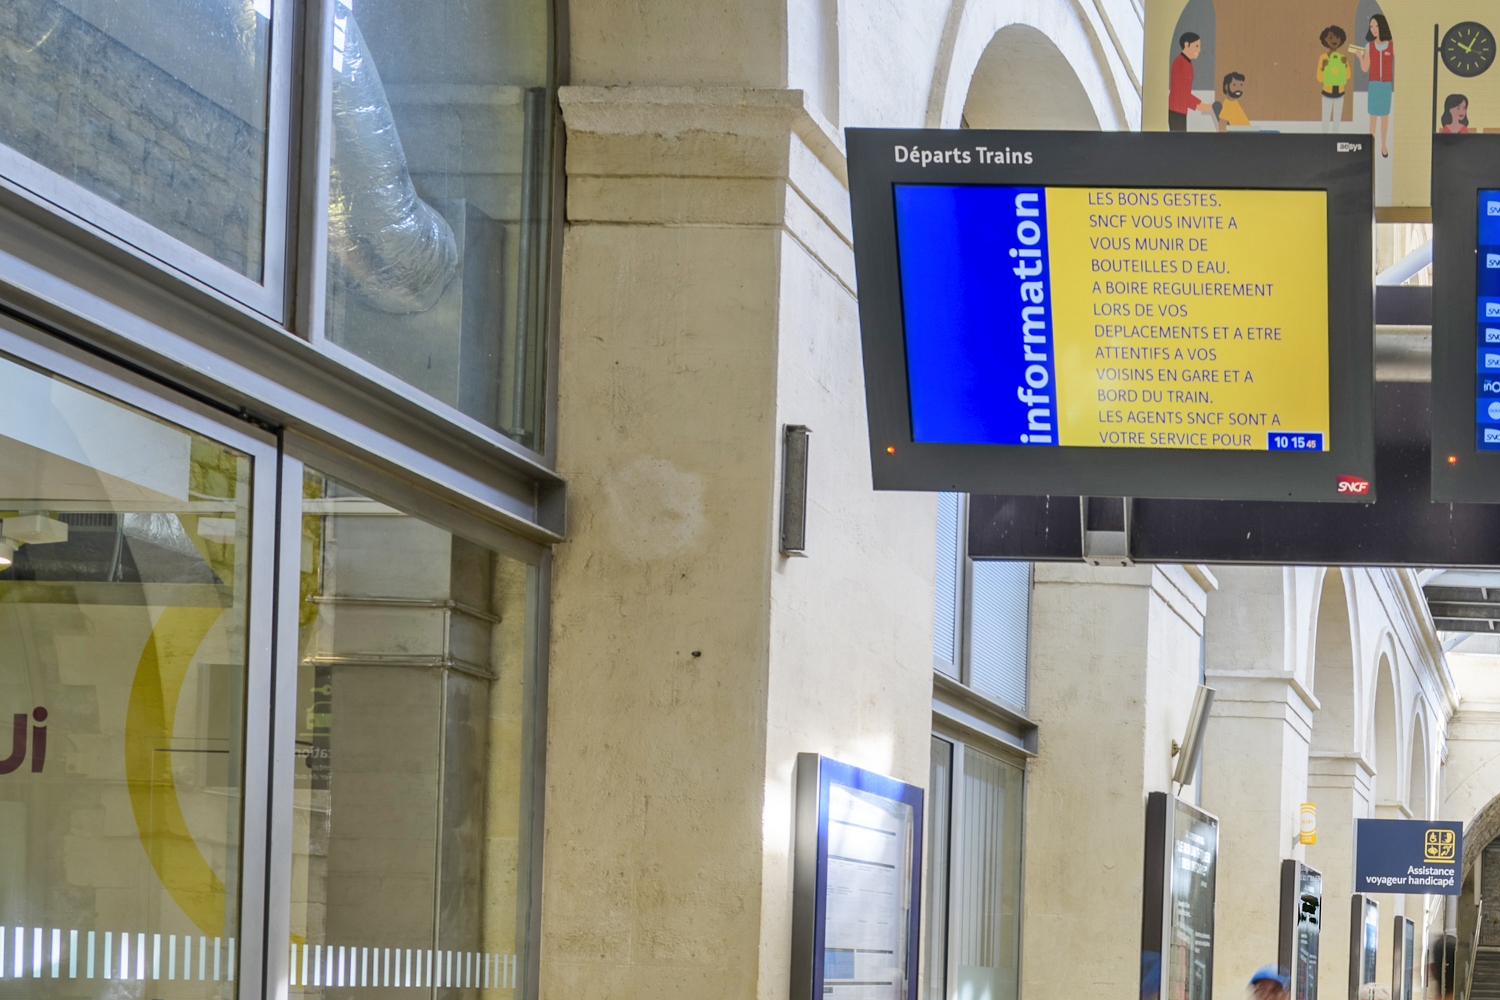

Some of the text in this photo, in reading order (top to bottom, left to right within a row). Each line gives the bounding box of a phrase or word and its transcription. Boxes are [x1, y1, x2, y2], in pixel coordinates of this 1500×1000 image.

[895, 146, 1033, 167] Départs Trains
[1089, 192, 1221, 206] LES BONS GESTES.
[1090, 214, 1237, 229] SNCF VOUS INVITE A
[1090, 237, 1207, 251] VOUS MUNIR DE
[1092, 259, 1229, 274] BOUTEILLES D EAU.
[1092, 281, 1273, 296] A BOIRE REGULIEREMENT
[1094, 303, 1187, 317] LORS DE VOS
[1009, 192, 1053, 444] information
[1095, 325, 1281, 340] DEPLACEMENTS ET A ETRE
[1096, 346, 1216, 361] ATTENTIFS A VOS
[1096, 368, 1253, 382] VOISINS EN GARE ET A
[1098, 389, 1213, 403] BORD DU TRAIN.
[1099, 410, 1281, 426] LES AGENTS SNCF SONT A
[1099, 431, 1251, 446] VOTRE SERVICE POUR
[1306, 440, 1316, 448] 45
[1338, 482, 1368, 492] SNCF
[1407, 866, 1454, 876] Assistance
[1366, 876, 1454, 887] voyageur handicapé
